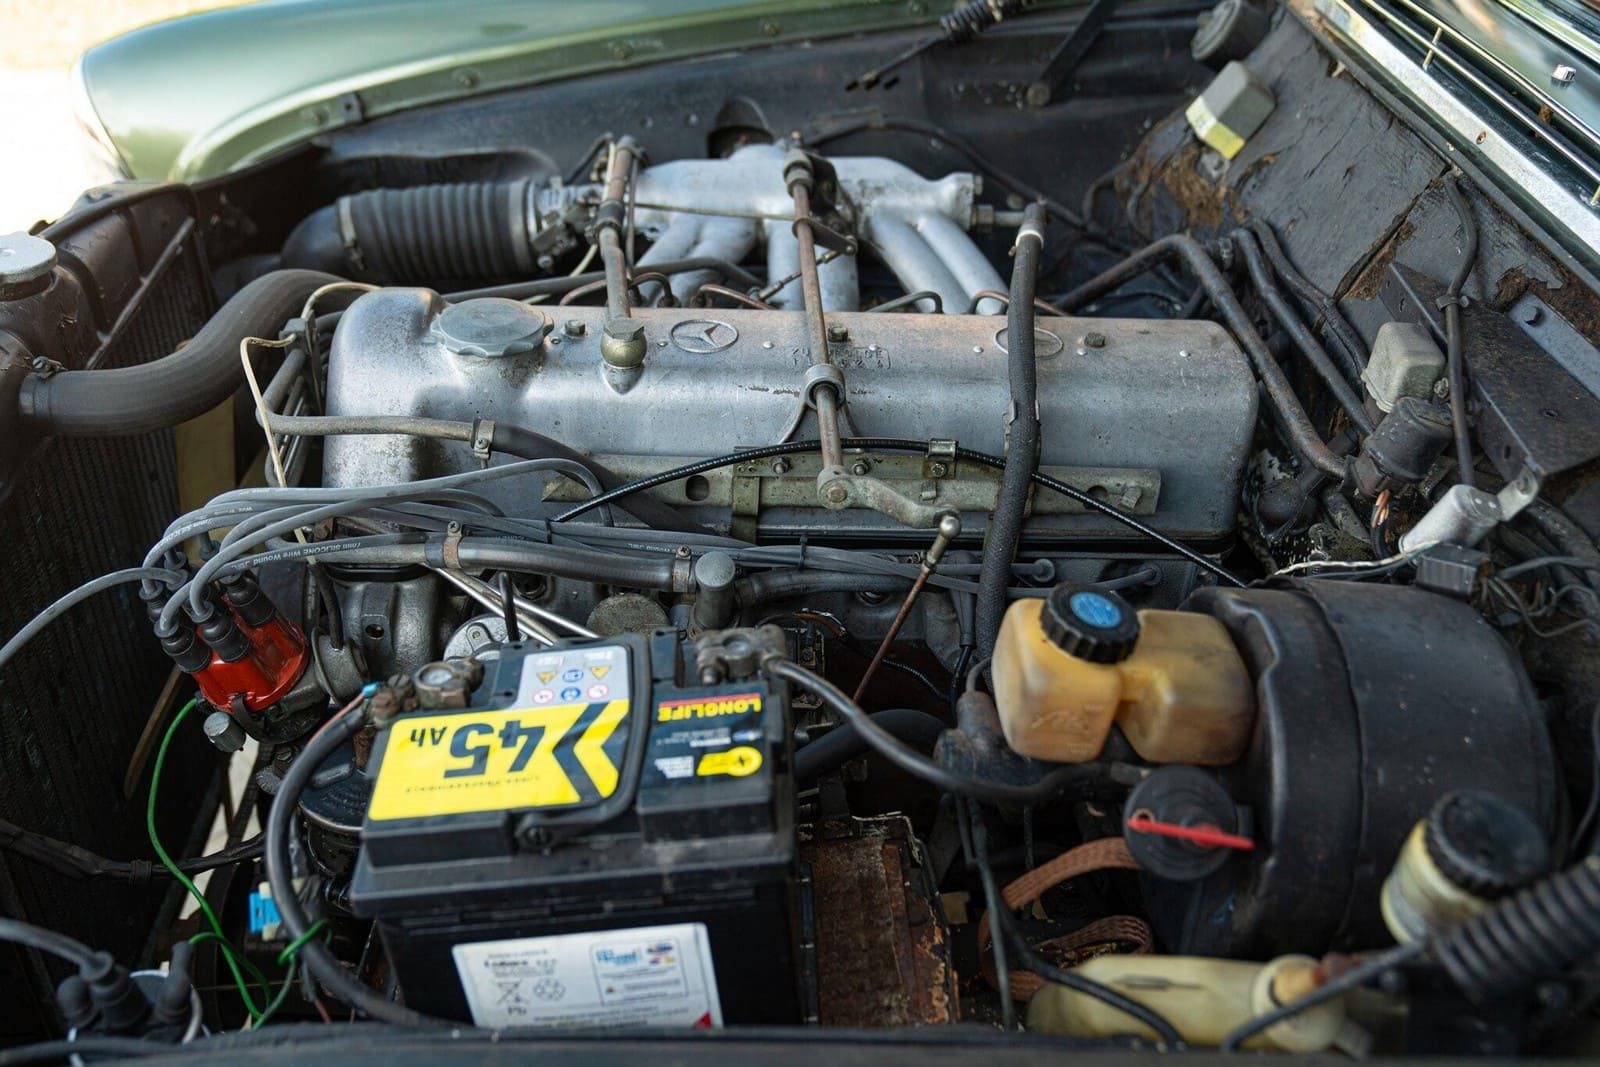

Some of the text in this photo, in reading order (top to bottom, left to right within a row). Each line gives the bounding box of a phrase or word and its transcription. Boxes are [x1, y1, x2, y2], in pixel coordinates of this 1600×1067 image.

[282, 550, 301, 558] Wire
[303, 544, 341, 555] SILICONE
[253, 553, 282, 566] Wound
[657, 697, 762, 722] LONGLIFE
[410, 720, 546, 778] 45 Ah
